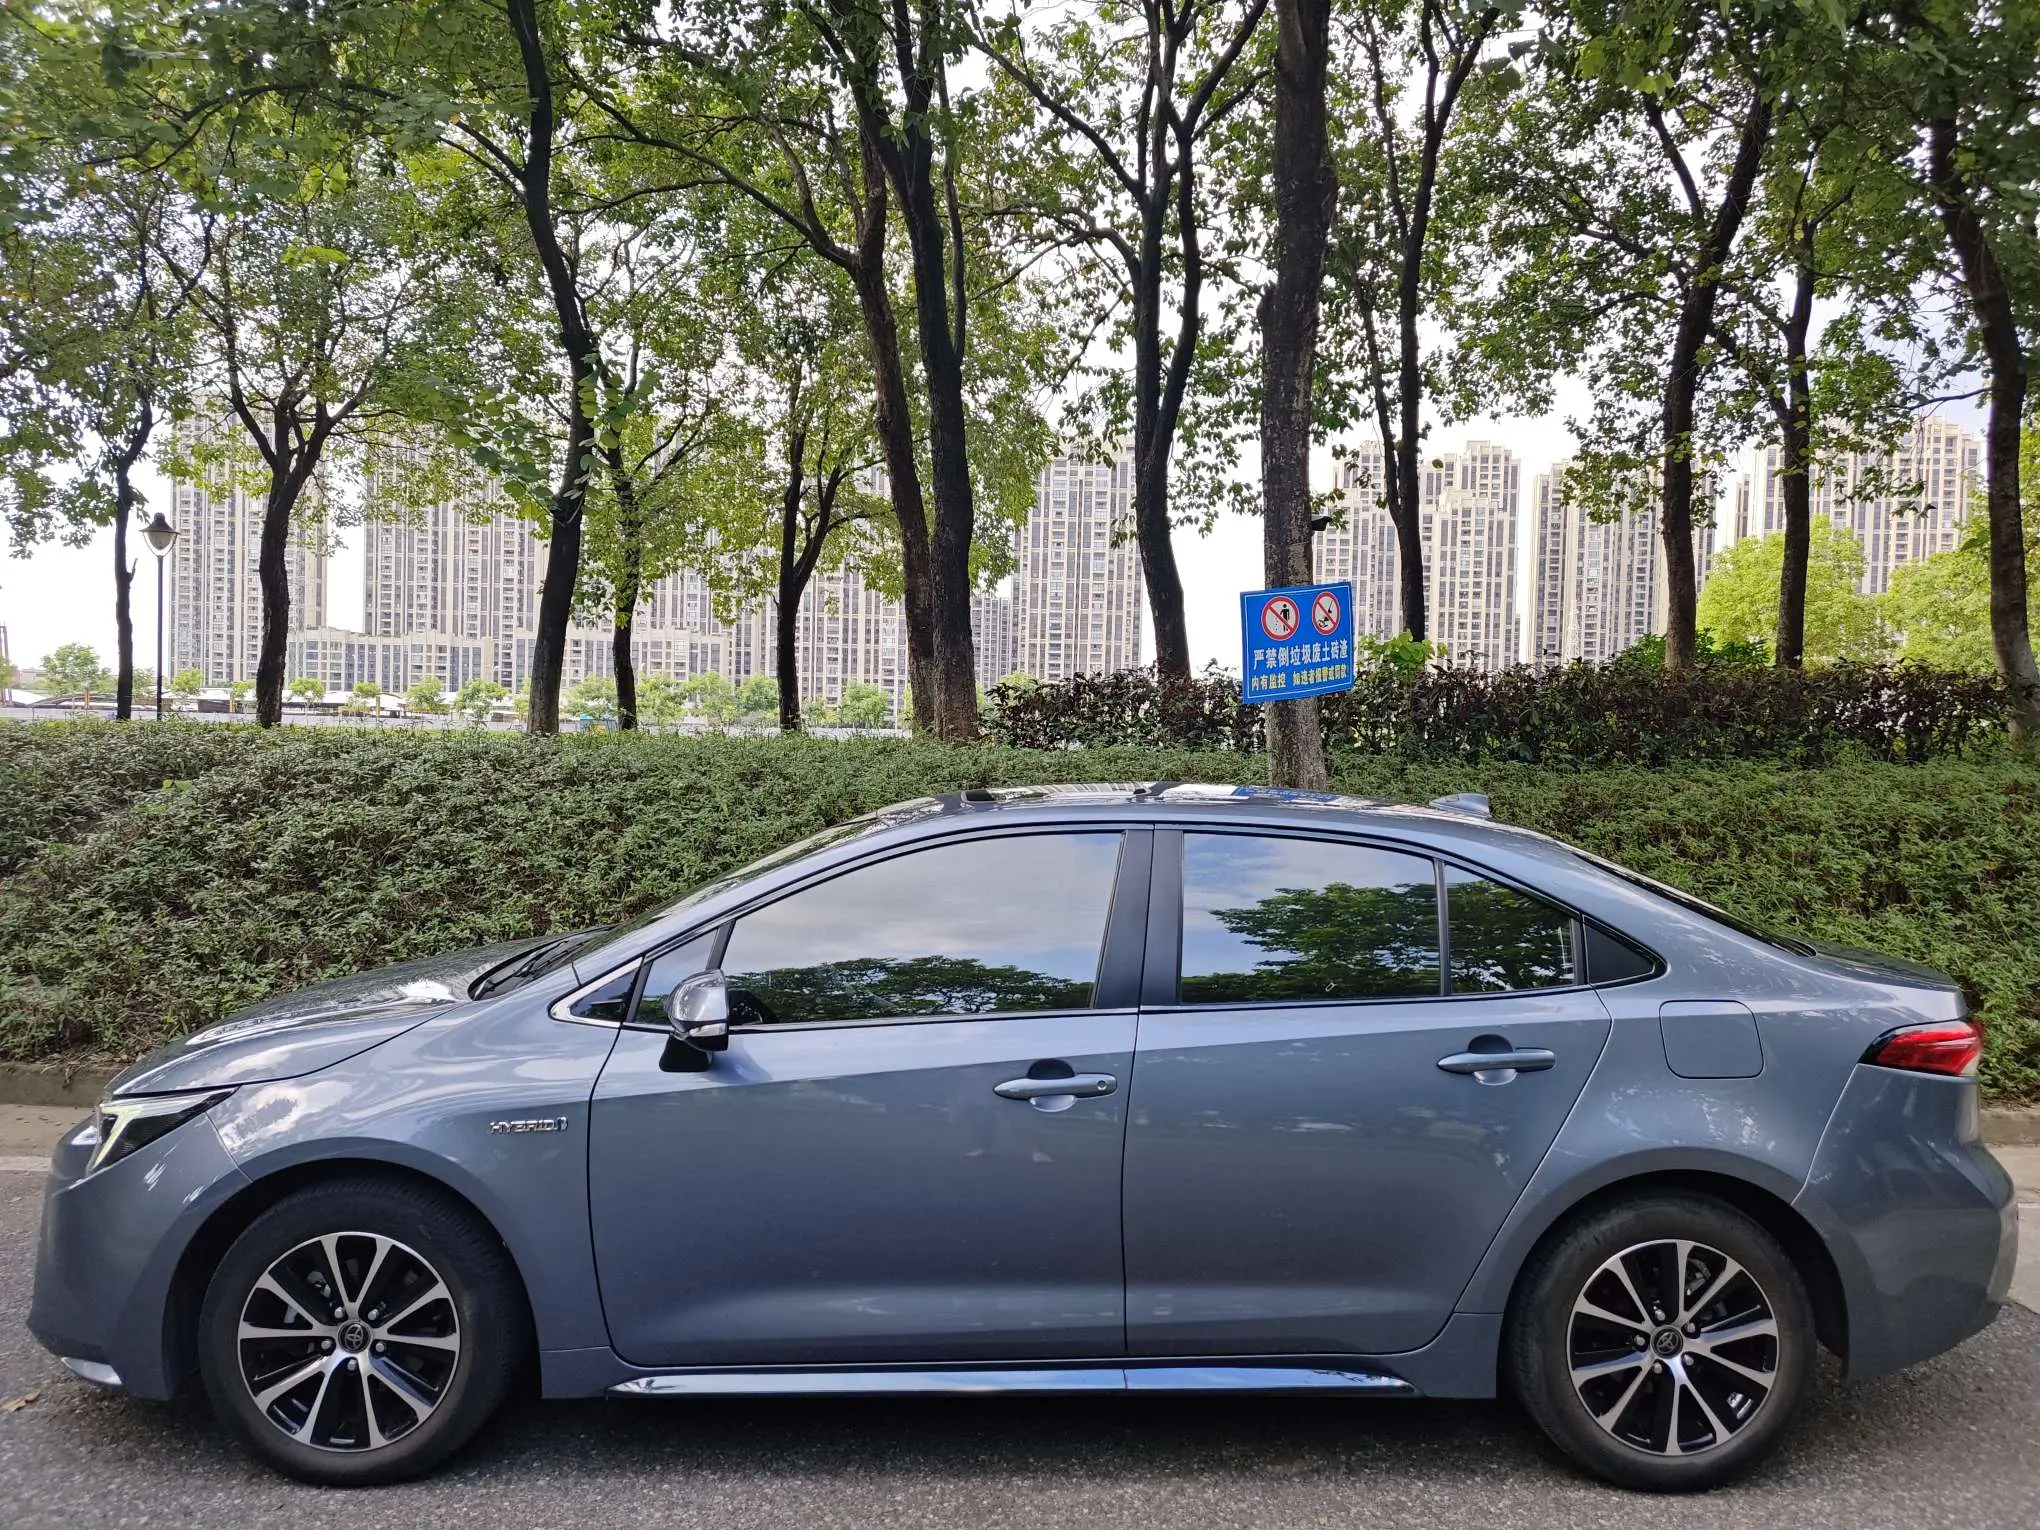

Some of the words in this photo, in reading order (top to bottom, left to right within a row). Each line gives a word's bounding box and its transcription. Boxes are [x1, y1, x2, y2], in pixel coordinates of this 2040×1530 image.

[1253, 639, 1348, 669] 严禁倒垃圾废土砖渣
[1251, 672, 1286, 690] 内有监控
[490, 1120, 555, 1133] HYBRID
